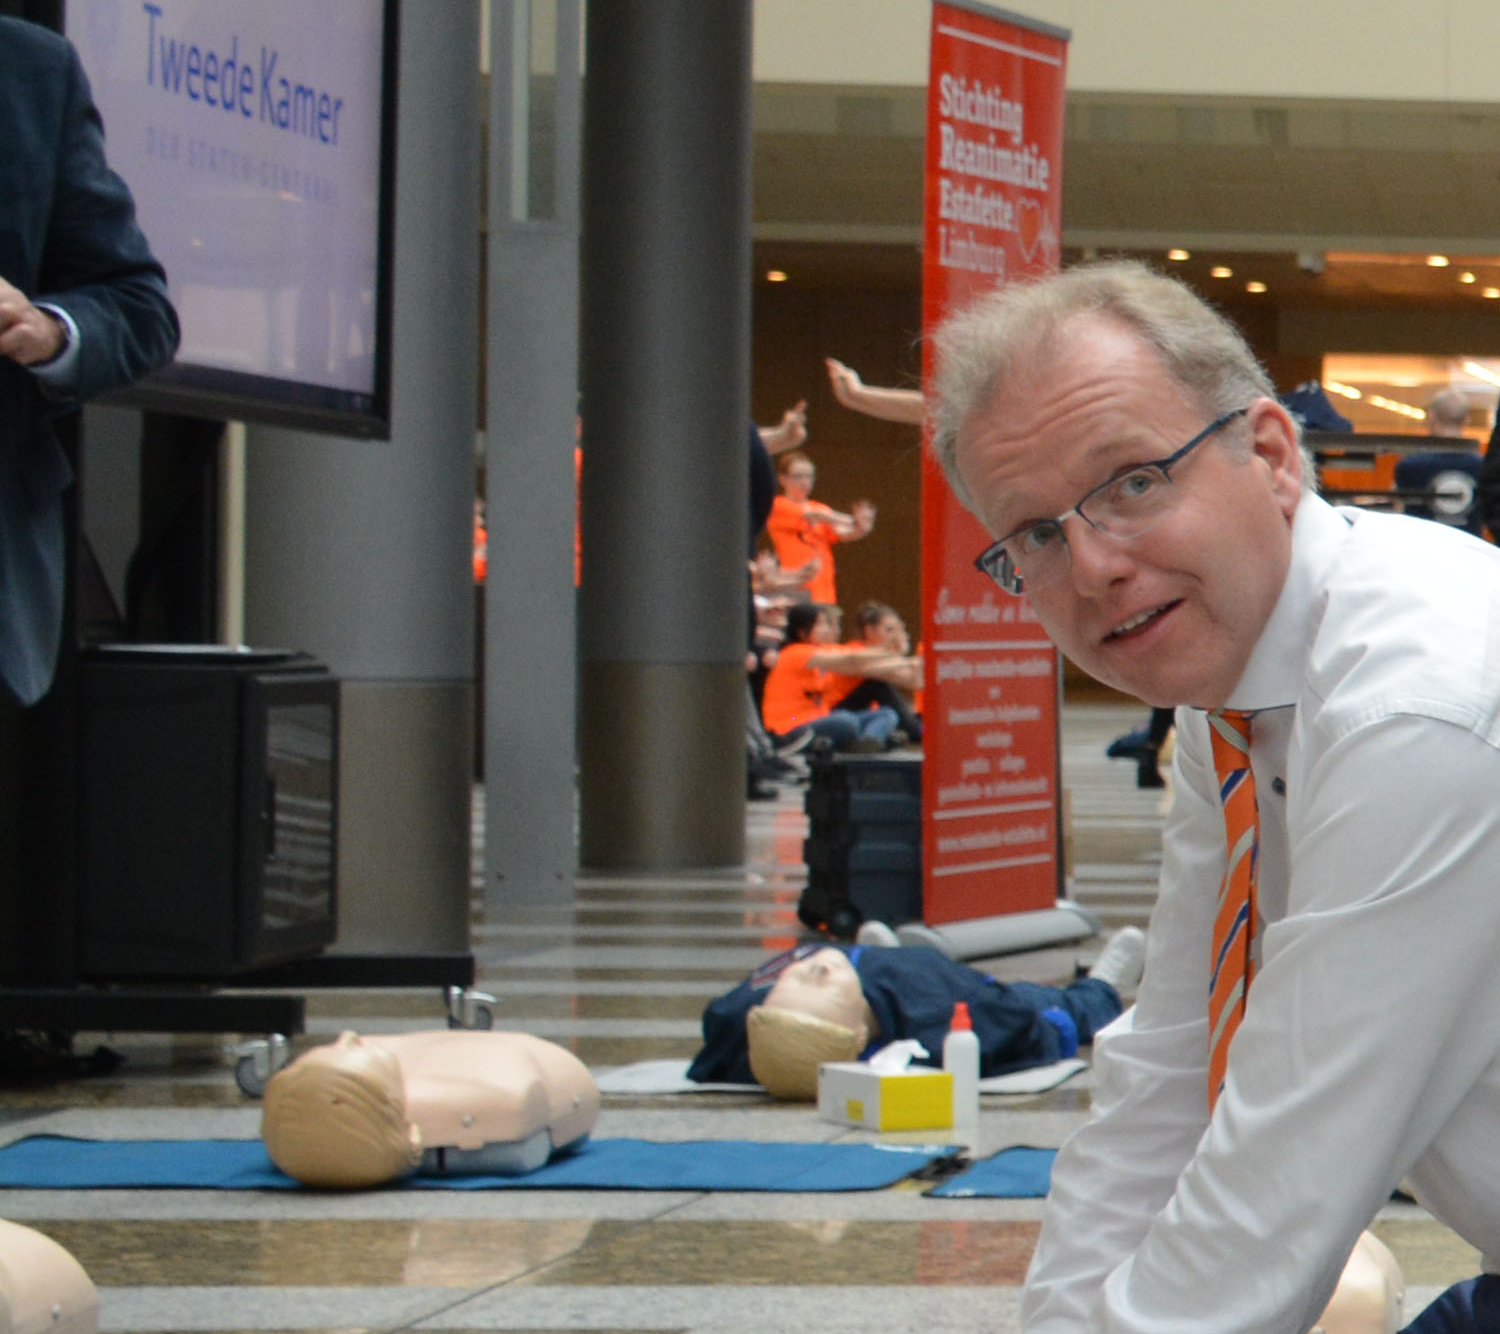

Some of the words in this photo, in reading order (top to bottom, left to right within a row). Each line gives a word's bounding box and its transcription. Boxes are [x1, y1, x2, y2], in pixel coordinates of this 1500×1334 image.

[143, 2, 255, 118] Tweede
[260, 45, 344, 146] Kamer
[938, 72, 1023, 145] Stichting
[938, 121, 1049, 192] Reanimatie
[938, 176, 1015, 233] Estafette
[938, 224, 1005, 287] Limburg
